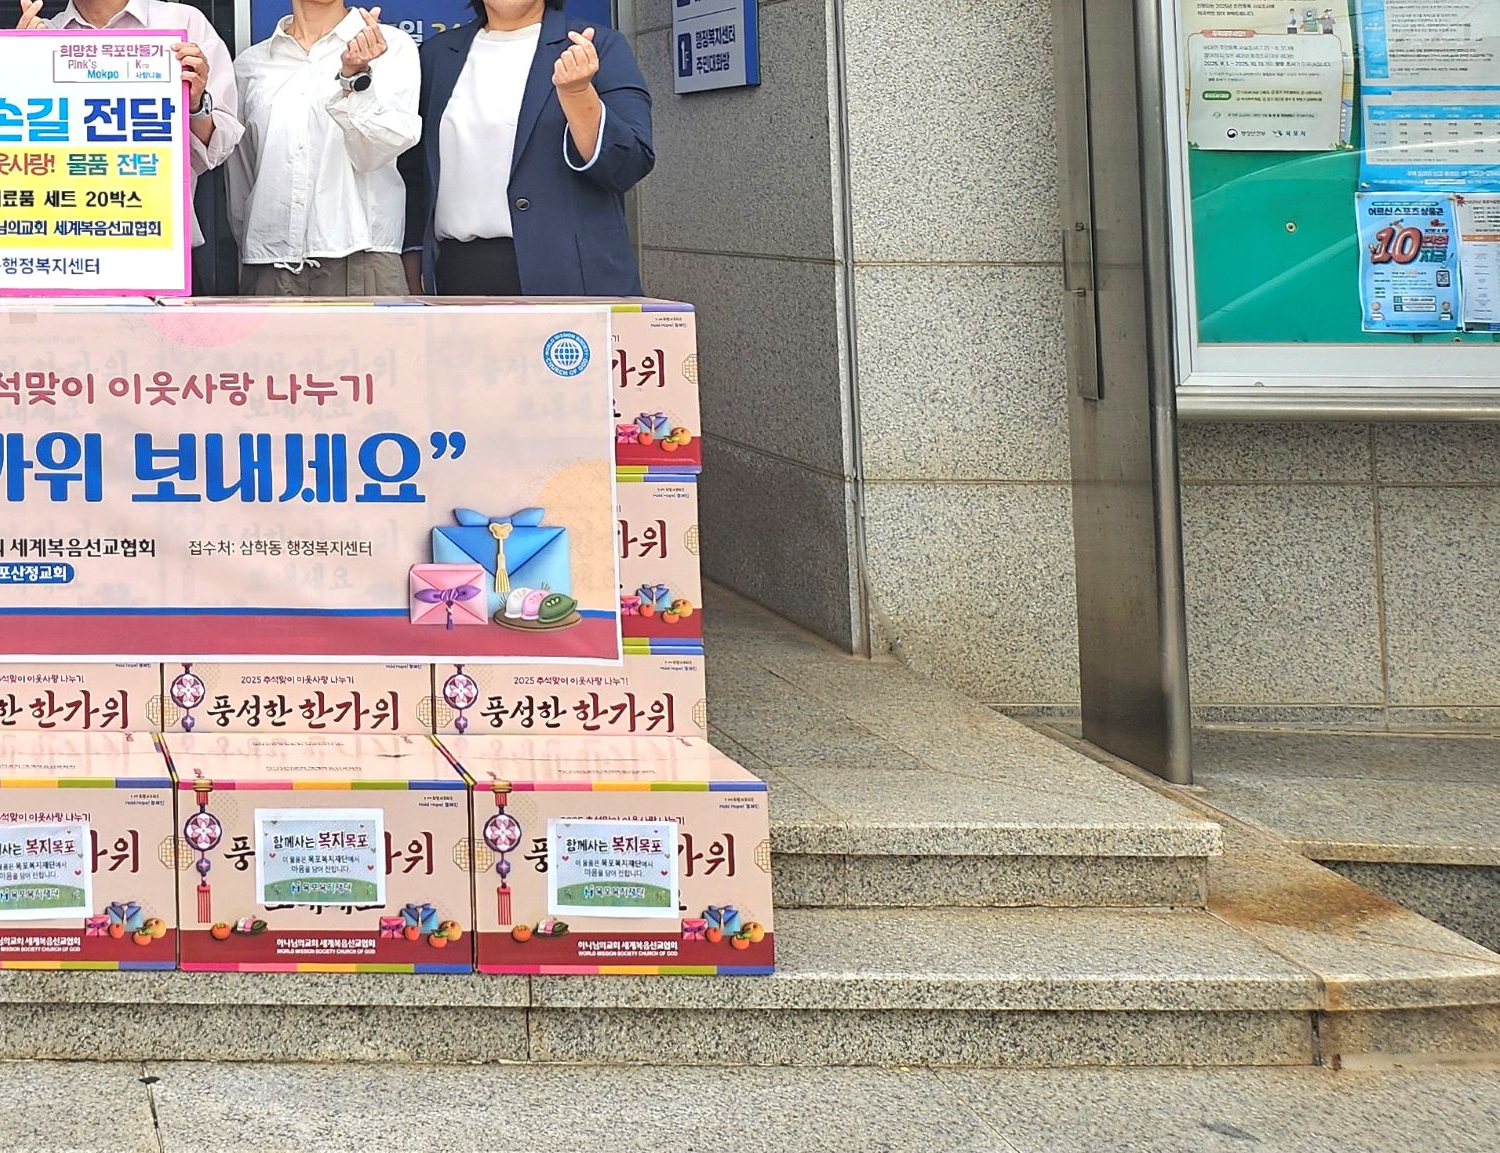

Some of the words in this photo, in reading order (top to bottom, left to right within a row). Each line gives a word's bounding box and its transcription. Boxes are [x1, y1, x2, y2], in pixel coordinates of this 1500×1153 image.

[60, 44, 98, 57] 희망찬
[101, 44, 164, 57] 목포만들기
[68, 59, 97, 69] Pink's
[87, 69, 119, 80] Mokpo
[83, 97, 176, 142] 전달
[66, 152, 109, 177] 물품
[116, 152, 159, 177] 전달
[44, 190, 77, 209] 세트
[85, 191, 143, 209] 20박스
[53, 219, 162, 236] 세계복음선교협회
[1370, 226, 1423, 265] 10
[611, 349, 665, 388] 가위
[108, 371, 255, 406] 이웃사랑
[266, 372, 374, 406] 나누기
[10, 538, 156, 558] 세계복음선교협회
[188, 539, 235, 556] 접수처:
[239, 539, 282, 556] 삼학동
[286, 539, 372, 556] 행정복지센터
[60, 675, 84, 684] 나누기
[240, 675, 262, 685] 2025
[330, 675, 354, 685] 나누기
[513, 676, 535, 686] 2025
[604, 676, 628, 686] 나누기
[29, 690, 128, 730] 한가위
[206, 694, 293, 727] 풍성한
[299, 691, 399, 731] 한가위
[480, 695, 567, 728] 풍성한
[573, 692, 675, 732] 한가위
[29, 813, 63, 822] 이웃사랑
[66, 813, 91, 822] 나누기
[25, 837, 75, 854] 복지목포
[273, 835, 315, 849] 함께사는
[318, 831, 368, 848] 복지목포
[566, 838, 608, 852] 함께사는
[611, 836, 662, 853] 복지목포
[678, 832, 735, 877] 가위
